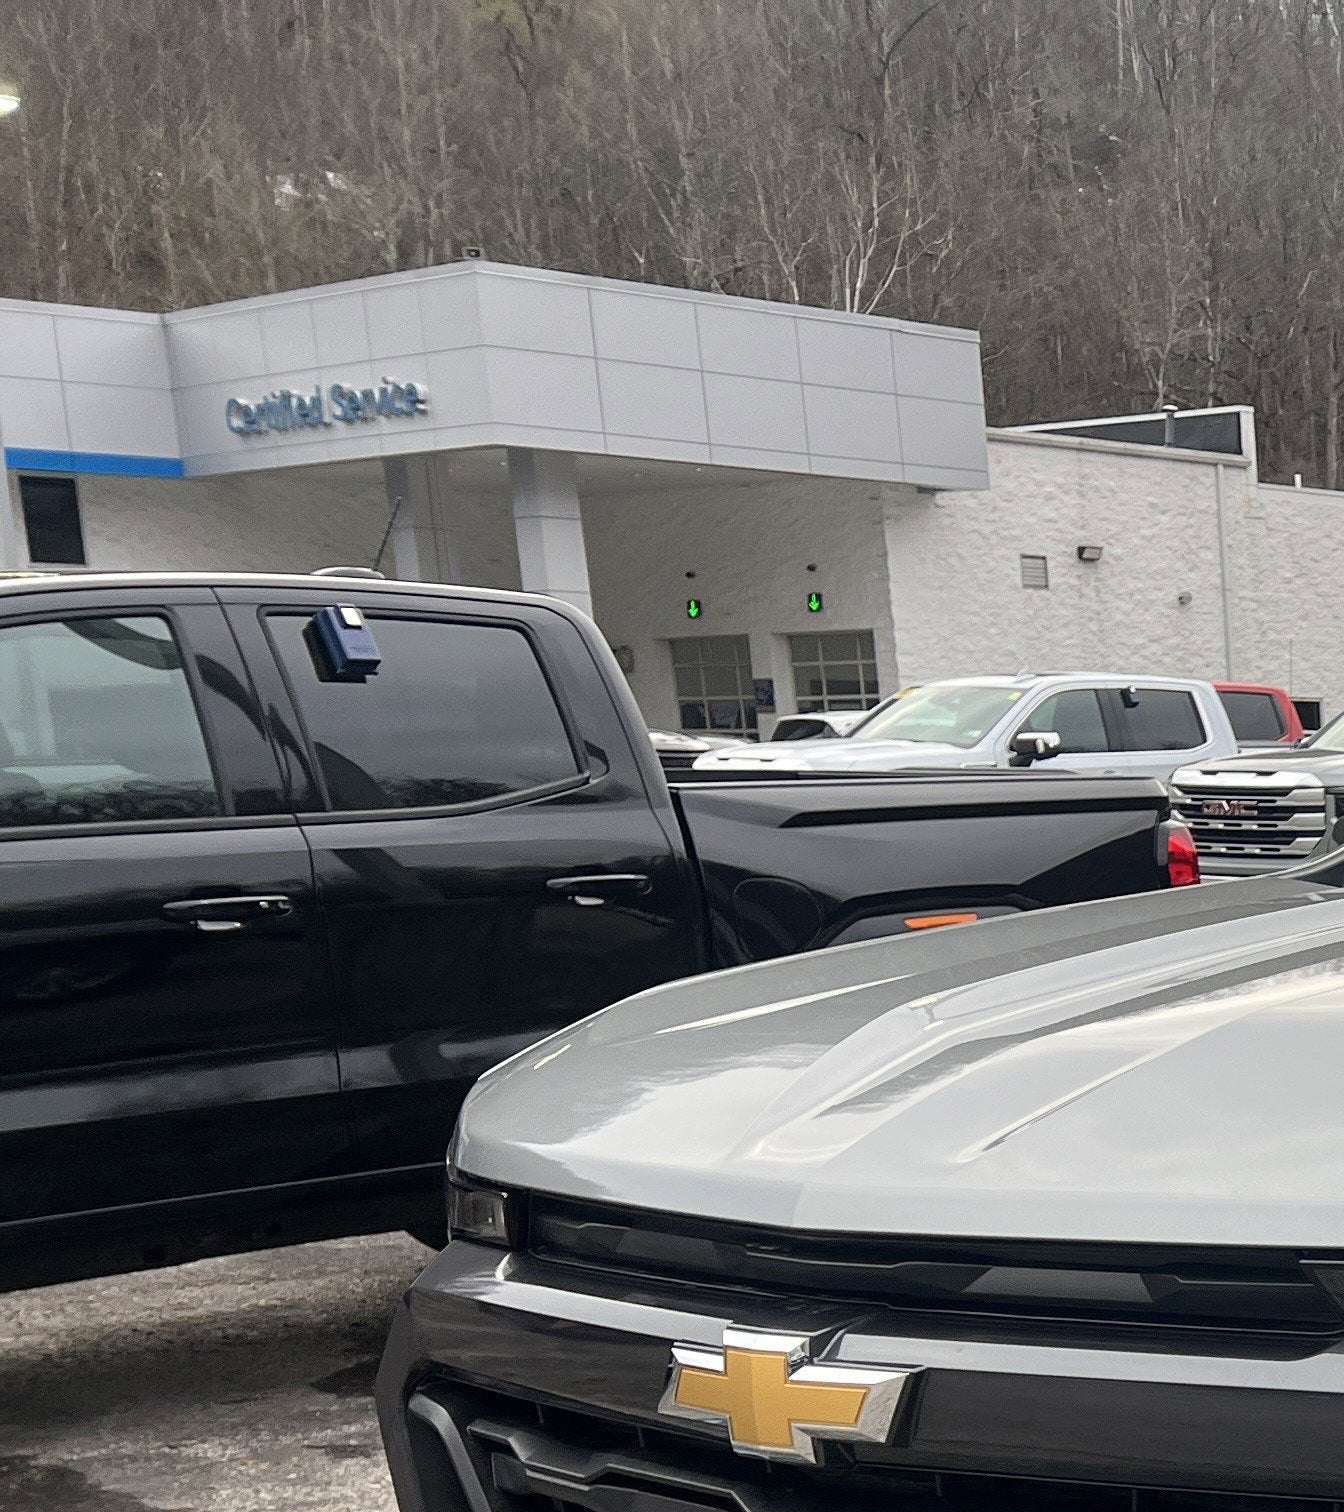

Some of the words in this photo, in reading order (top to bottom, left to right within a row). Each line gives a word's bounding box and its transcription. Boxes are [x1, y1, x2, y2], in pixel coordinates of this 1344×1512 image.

[226, 383, 332, 436] Certified
[331, 377, 428, 425] Service
[1202, 799, 1258, 816] GMC
